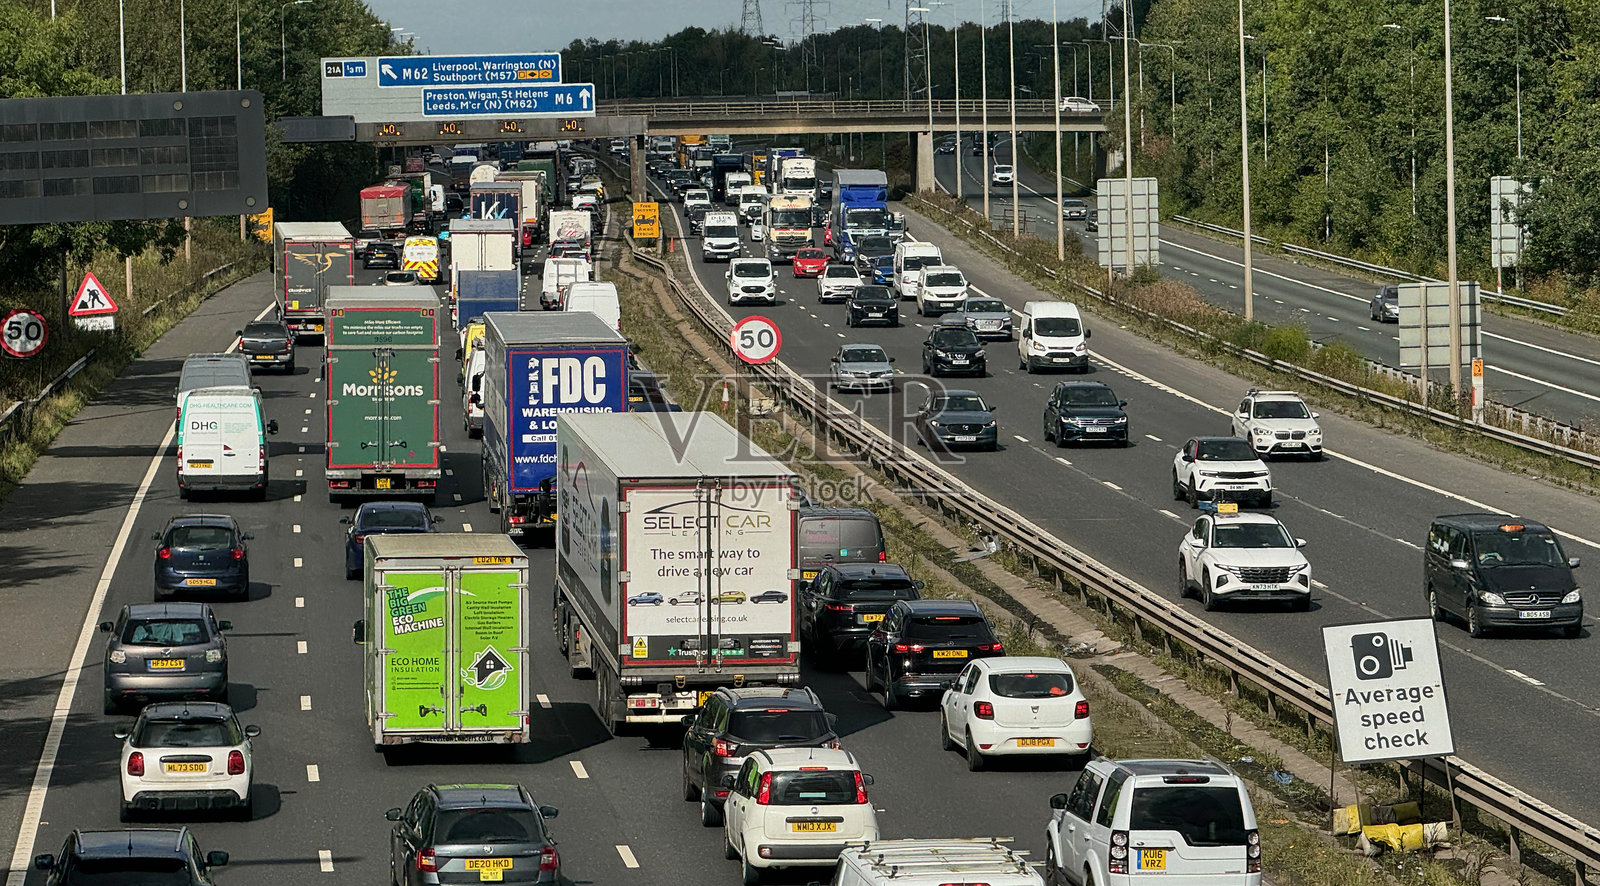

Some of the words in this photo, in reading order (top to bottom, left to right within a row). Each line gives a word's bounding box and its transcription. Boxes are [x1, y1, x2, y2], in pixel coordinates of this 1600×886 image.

[482, 60, 536, 71] Warrington
[538, 58, 556, 69] (N)
[402, 67, 428, 80] M62
[433, 72, 482, 82] Southport
[486, 70, 518, 81] (M57)
[501, 90, 512, 99] St
[516, 90, 549, 98] Helens
[554, 94, 573, 104] M6
[484, 100, 502, 110] (N)
[504, 99, 538, 110] (M62)
[383, 124, 395, 134] 40
[442, 122, 456, 132] 40
[504, 122, 517, 130] 40
[566, 120, 577, 129] 40
[8, 320, 42, 340] 50
[740, 328, 774, 349] 50
[542, 356, 606, 404] FDC
[522, 406, 612, 417] WAREHOUSING
[192, 421, 218, 430] DHG
[529, 420, 538, 430] &
[644, 515, 718, 530] SELECT
[726, 514, 771, 528] CAR
[650, 549, 674, 560] The
[678, 548, 714, 559] smart
[719, 549, 743, 560] way
[747, 548, 760, 558] to
[658, 566, 690, 577] drive
[694, 568, 701, 577] a
[735, 567, 754, 576] car
[387, 587, 408, 600] THE
[390, 597, 408, 608] BIG
[391, 602, 426, 616] GREEN
[392, 614, 414, 626] ECO
[394, 618, 444, 635] MACHINE
[1345, 686, 1434, 705] Average
[1361, 706, 1425, 729] speed
[1364, 729, 1429, 750] check
[1144, 850, 1163, 858] KU16
